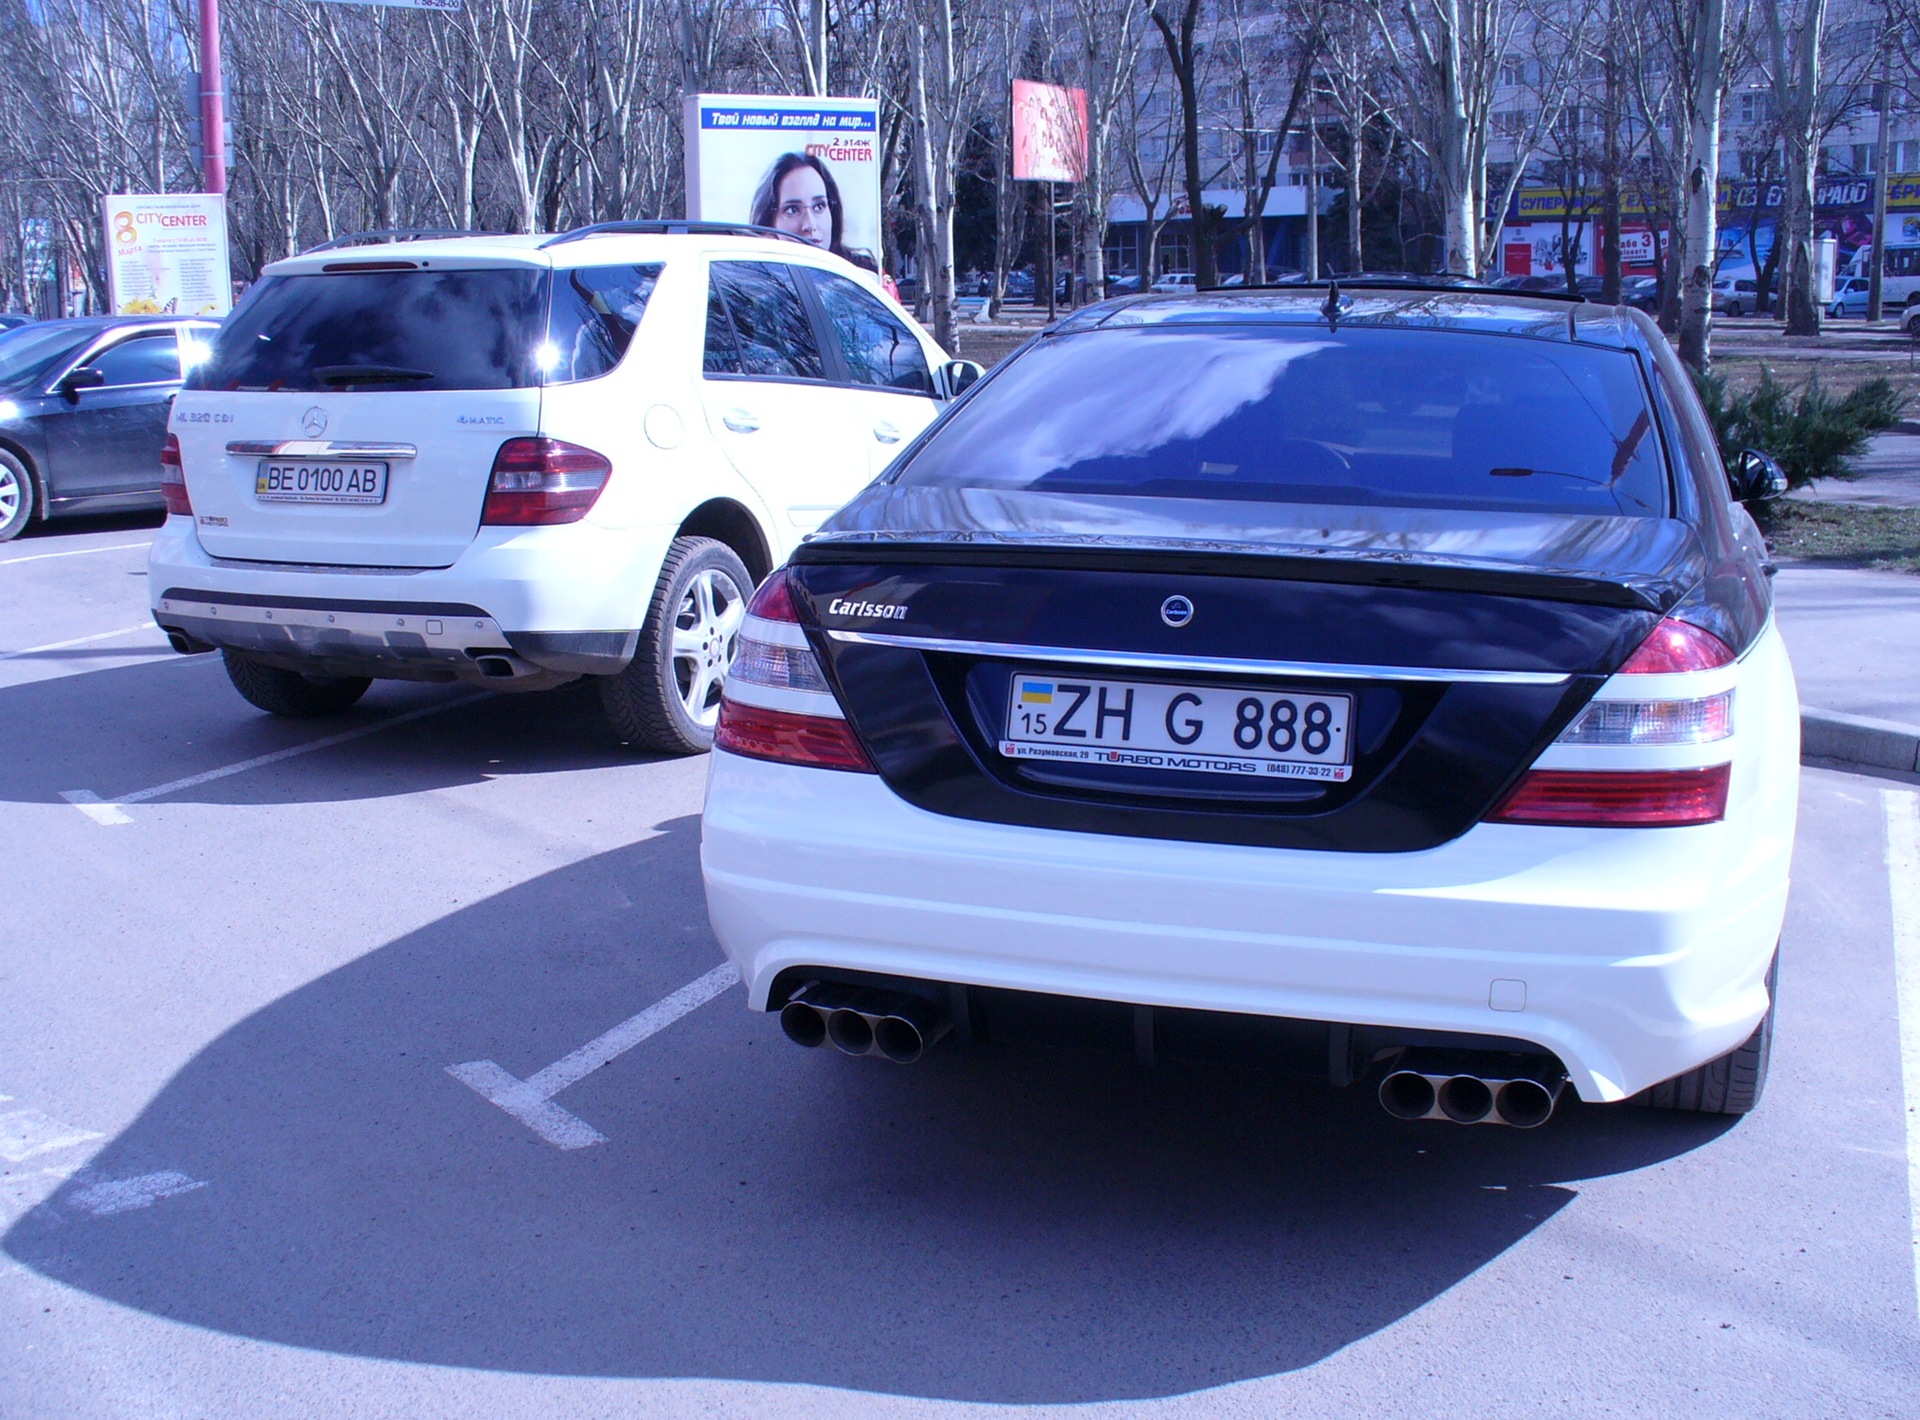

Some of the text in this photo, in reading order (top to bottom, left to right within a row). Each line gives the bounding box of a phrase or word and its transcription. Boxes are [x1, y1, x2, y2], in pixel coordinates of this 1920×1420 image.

[712, 112, 739, 125] Твой
[742, 112, 779, 126] новый
[781, 113, 820, 126] взгляд
[822, 115, 837, 127] на
[833, 137, 840, 146] 2
[829, 148, 872, 161] CENTER
[114, 210, 137, 244] 8
[136, 213, 207, 227] CITY CENTER
[1641, 234, 1651, 247] 3
[118, 246, 142, 257] Марта
[189, 412, 211, 423] 320
[829, 599, 908, 619] Carlsson
[1021, 684, 1332, 755] 15 ZH G 888
[1095, 751, 1331, 776] TURBO MOTORS (048) 777-33-22
